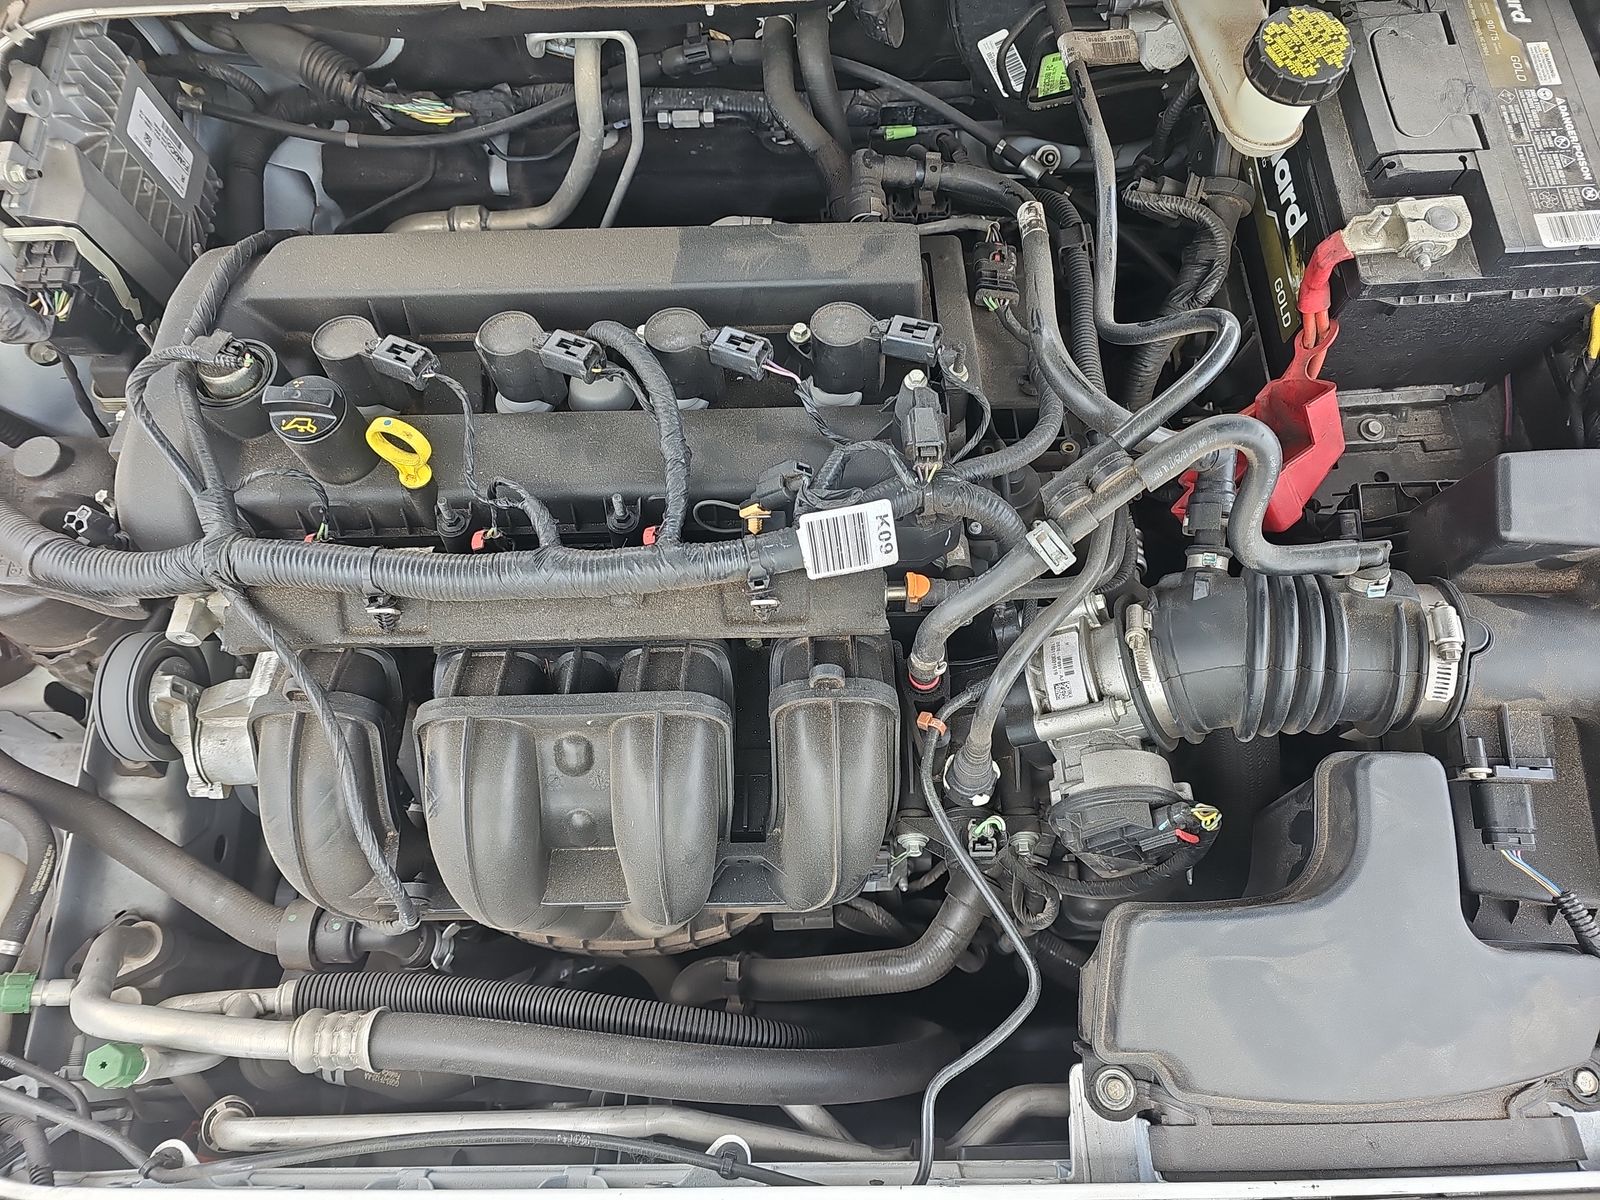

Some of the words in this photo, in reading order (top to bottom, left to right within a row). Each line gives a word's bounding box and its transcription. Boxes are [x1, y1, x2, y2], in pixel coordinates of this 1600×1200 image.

[1511, 56, 1526, 81] GOLD
[1558, 105, 1592, 180] DANGER/POISON
[1274, 277, 1292, 328] GOLD
[876, 514, 894, 554] K09
